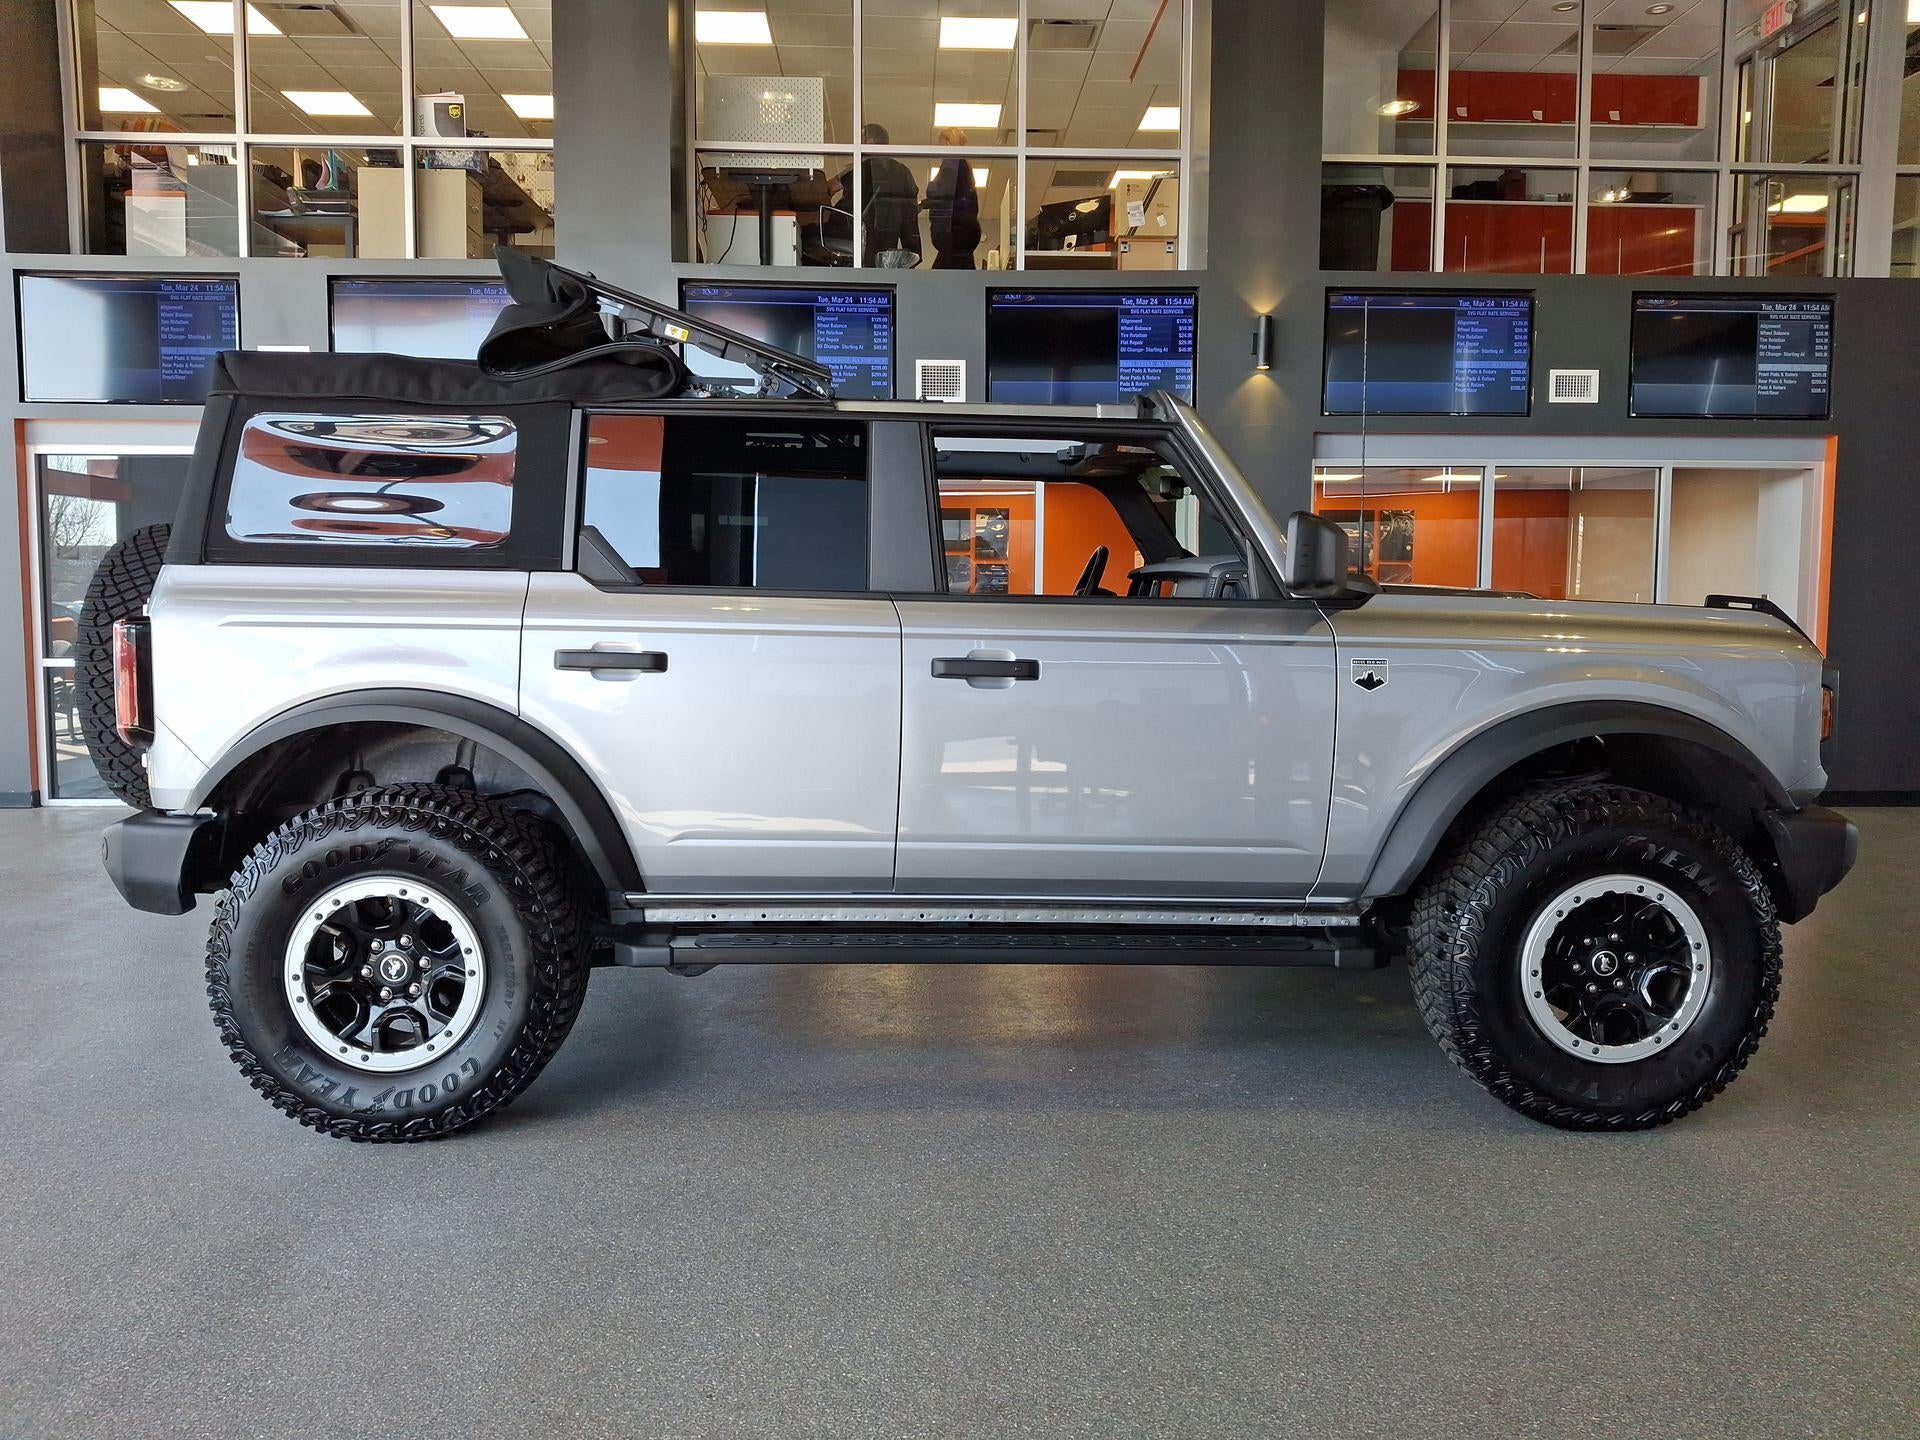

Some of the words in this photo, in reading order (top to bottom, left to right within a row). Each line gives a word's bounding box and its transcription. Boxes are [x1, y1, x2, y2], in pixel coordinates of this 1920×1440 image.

[1764, 1, 1783, 35] EXIT
[161, 284, 174, 292] Tue,
[818, 296, 830, 304] Tue,
